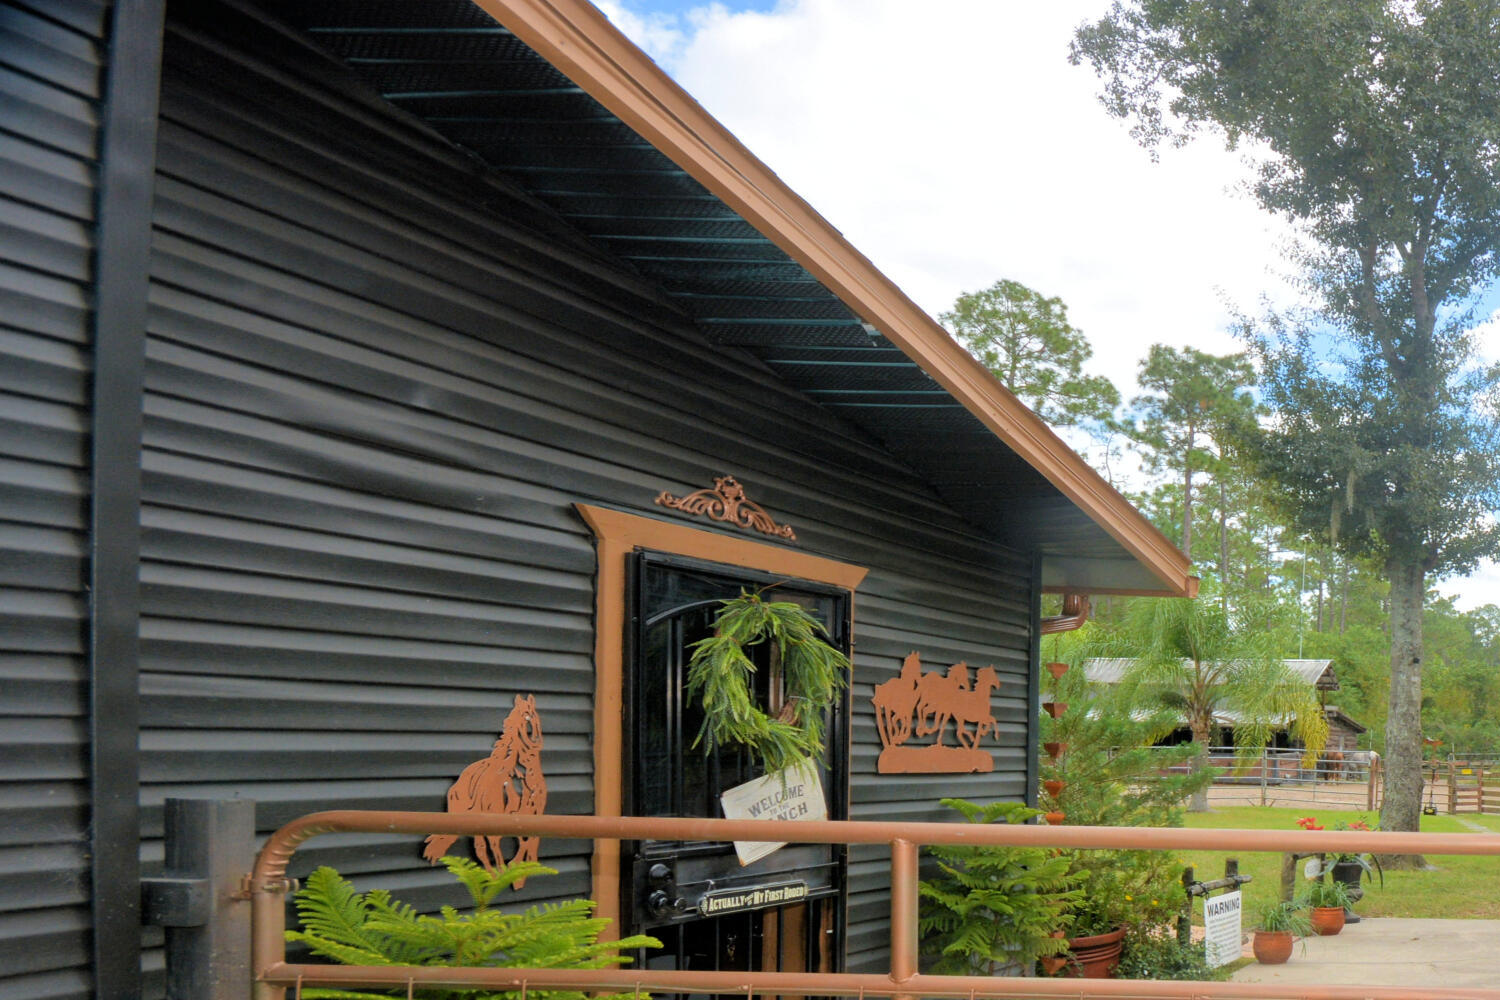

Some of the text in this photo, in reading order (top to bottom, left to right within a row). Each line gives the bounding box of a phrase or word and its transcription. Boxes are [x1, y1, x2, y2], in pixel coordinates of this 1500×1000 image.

[748, 785, 804, 817] WELCOME
[768, 801, 808, 821] NCH
[708, 895, 746, 912] ACTUALLY
[753, 891, 764, 905] MY
[764, 889, 784, 903] FIRST
[784, 886, 804, 900] RODEO
[1207, 897, 1240, 917] WARNING
